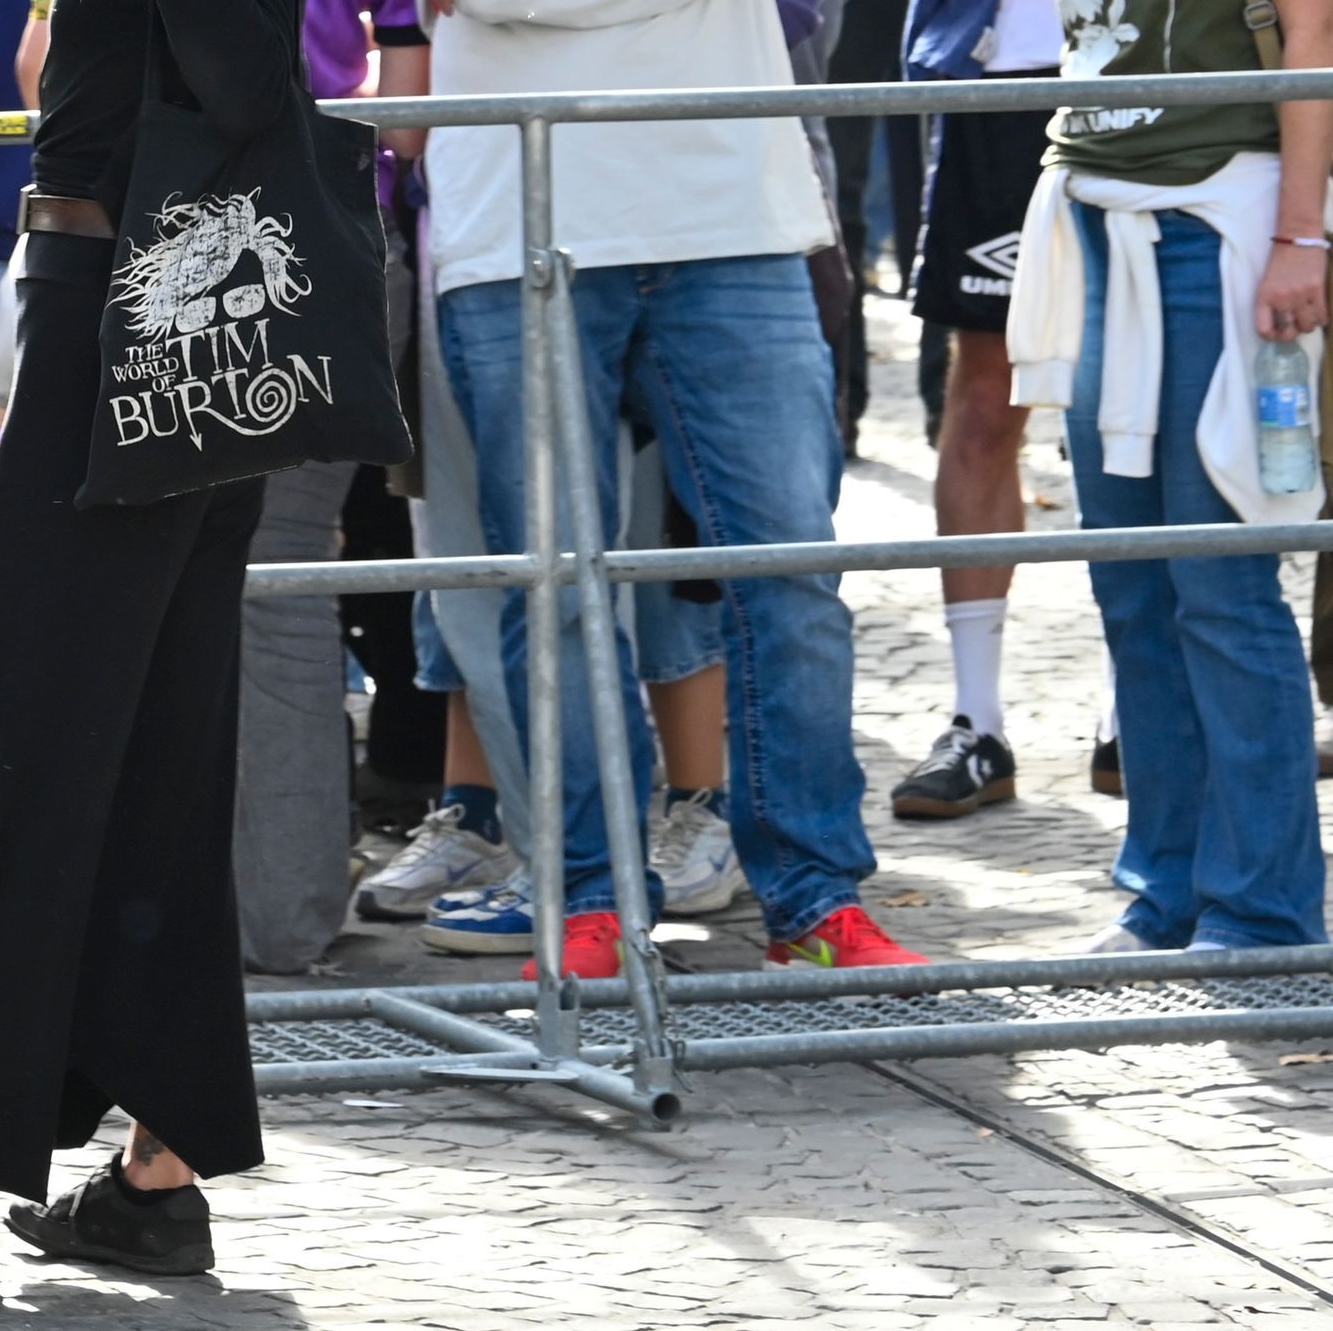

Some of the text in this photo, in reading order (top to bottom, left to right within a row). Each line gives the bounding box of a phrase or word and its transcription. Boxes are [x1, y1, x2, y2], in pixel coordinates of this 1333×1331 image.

[124, 342, 165, 365] THE
[164, 317, 274, 382] TIM
[111, 356, 180, 383] WORLD
[151, 373, 177, 394] OF
[108, 353, 334, 452] BURTON
